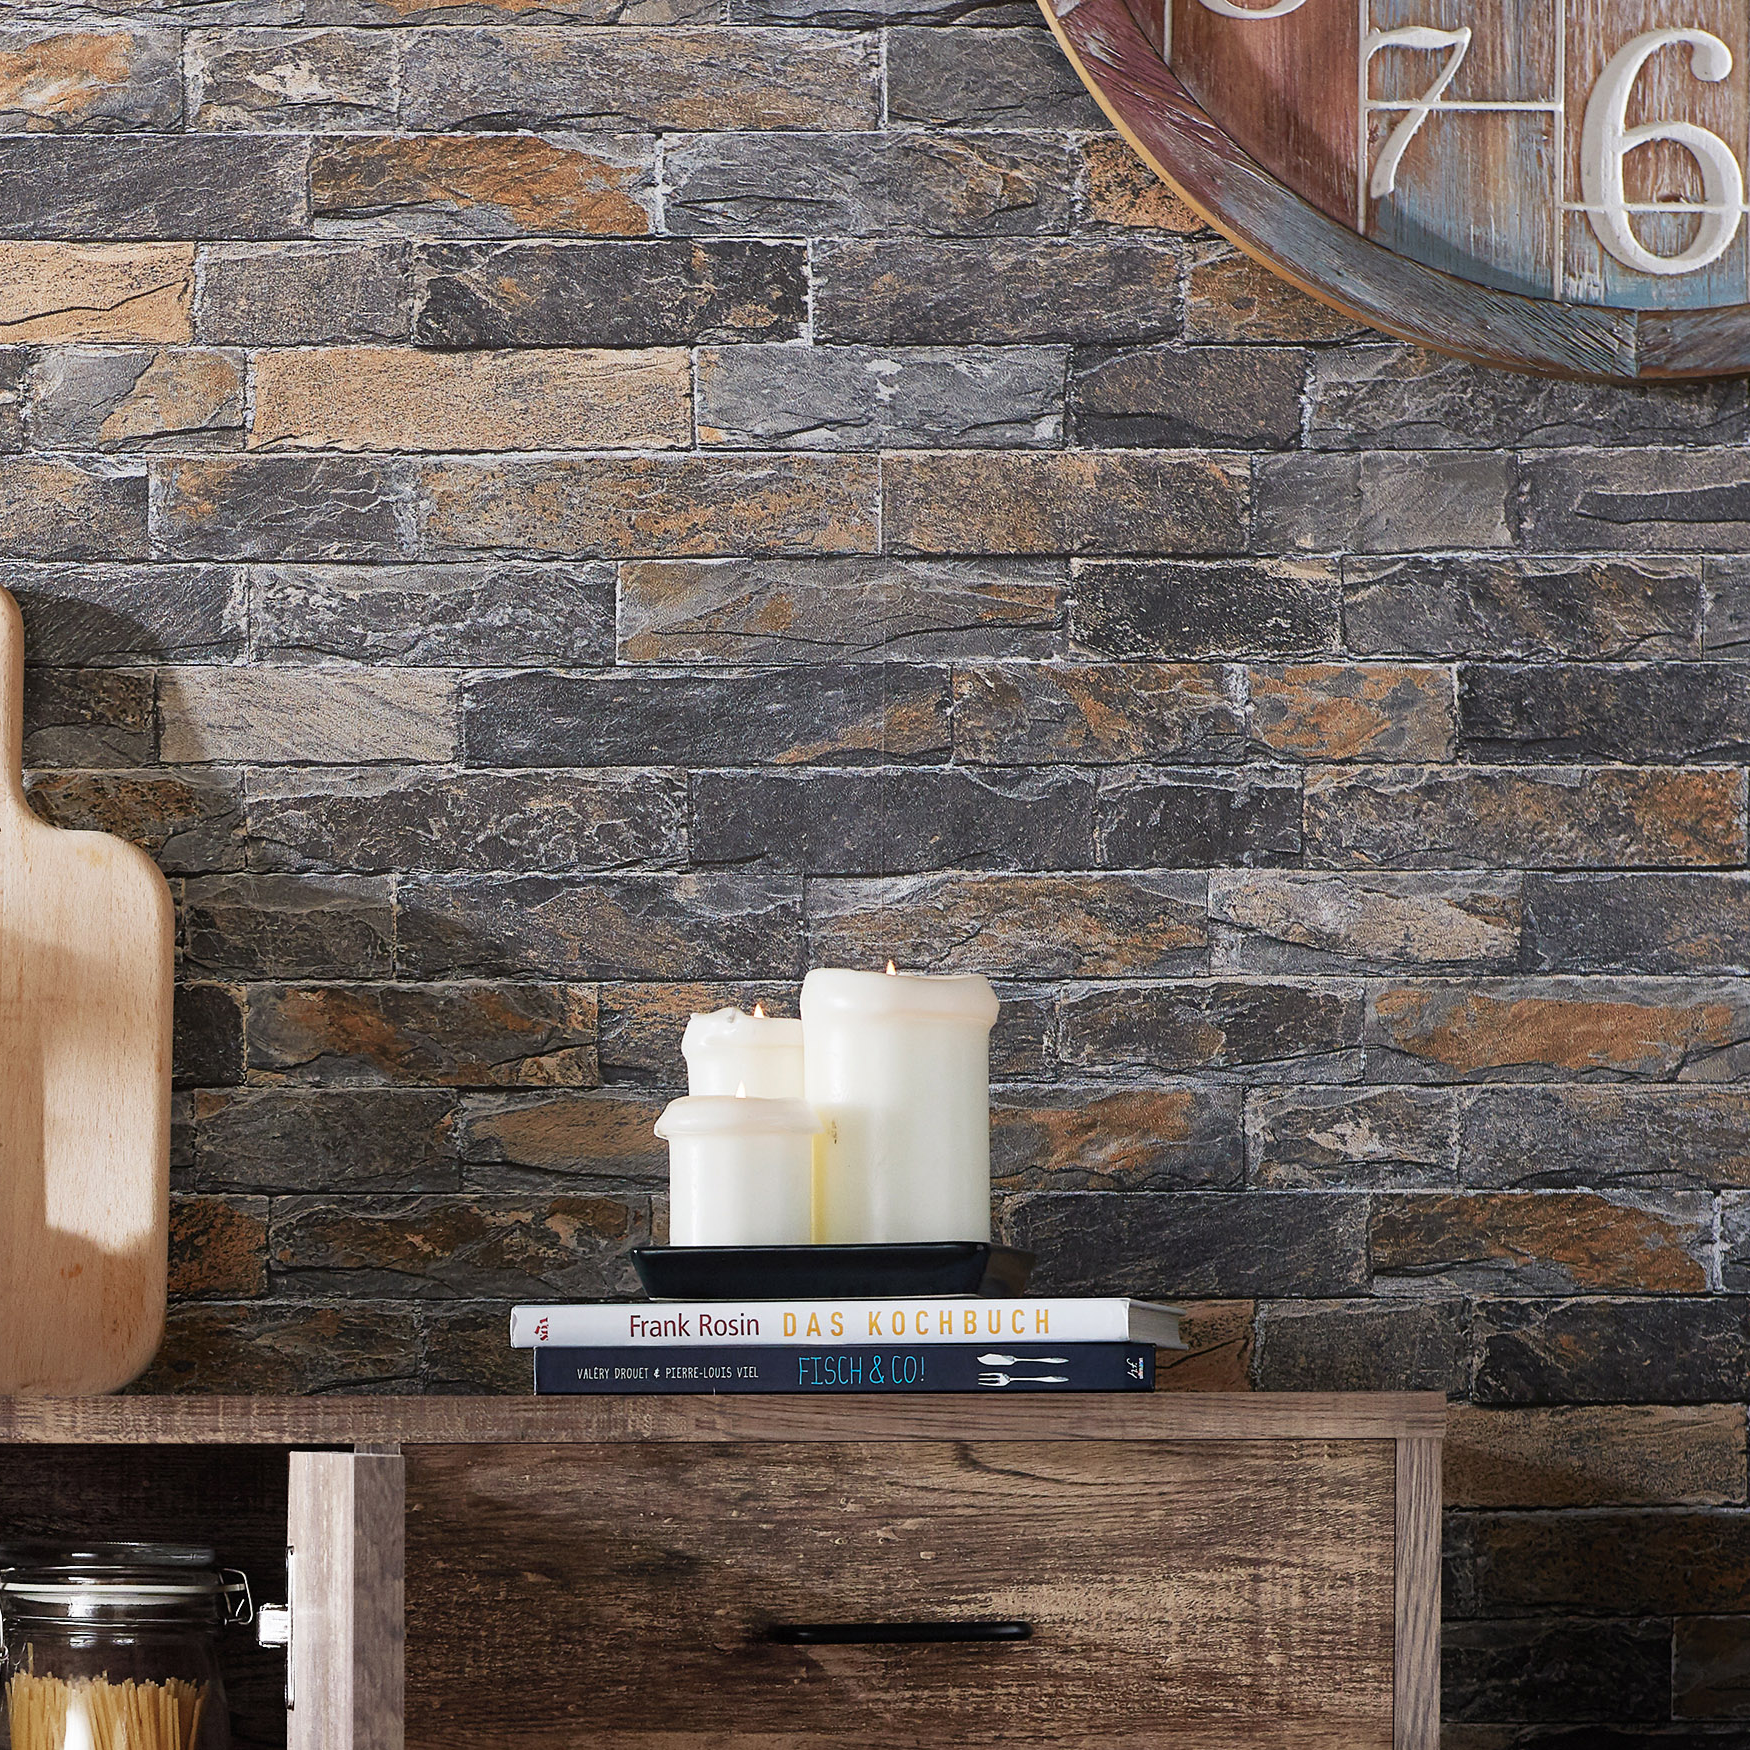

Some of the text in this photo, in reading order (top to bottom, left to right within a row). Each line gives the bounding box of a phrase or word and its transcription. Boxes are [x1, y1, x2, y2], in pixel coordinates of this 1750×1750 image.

[1362, 26, 1472, 198] 7
[1580, 27, 1744, 275] 6
[629, 1308, 1049, 1338] Frank Rosin DAS KOCHBUCH
[614, 1367, 649, 1380] DROUET
[665, 1366, 732, 1379] PIERRE-LOUIS
[736, 1366, 759, 1378] VIEL
[798, 1355, 925, 1385] FISCH & CO!
